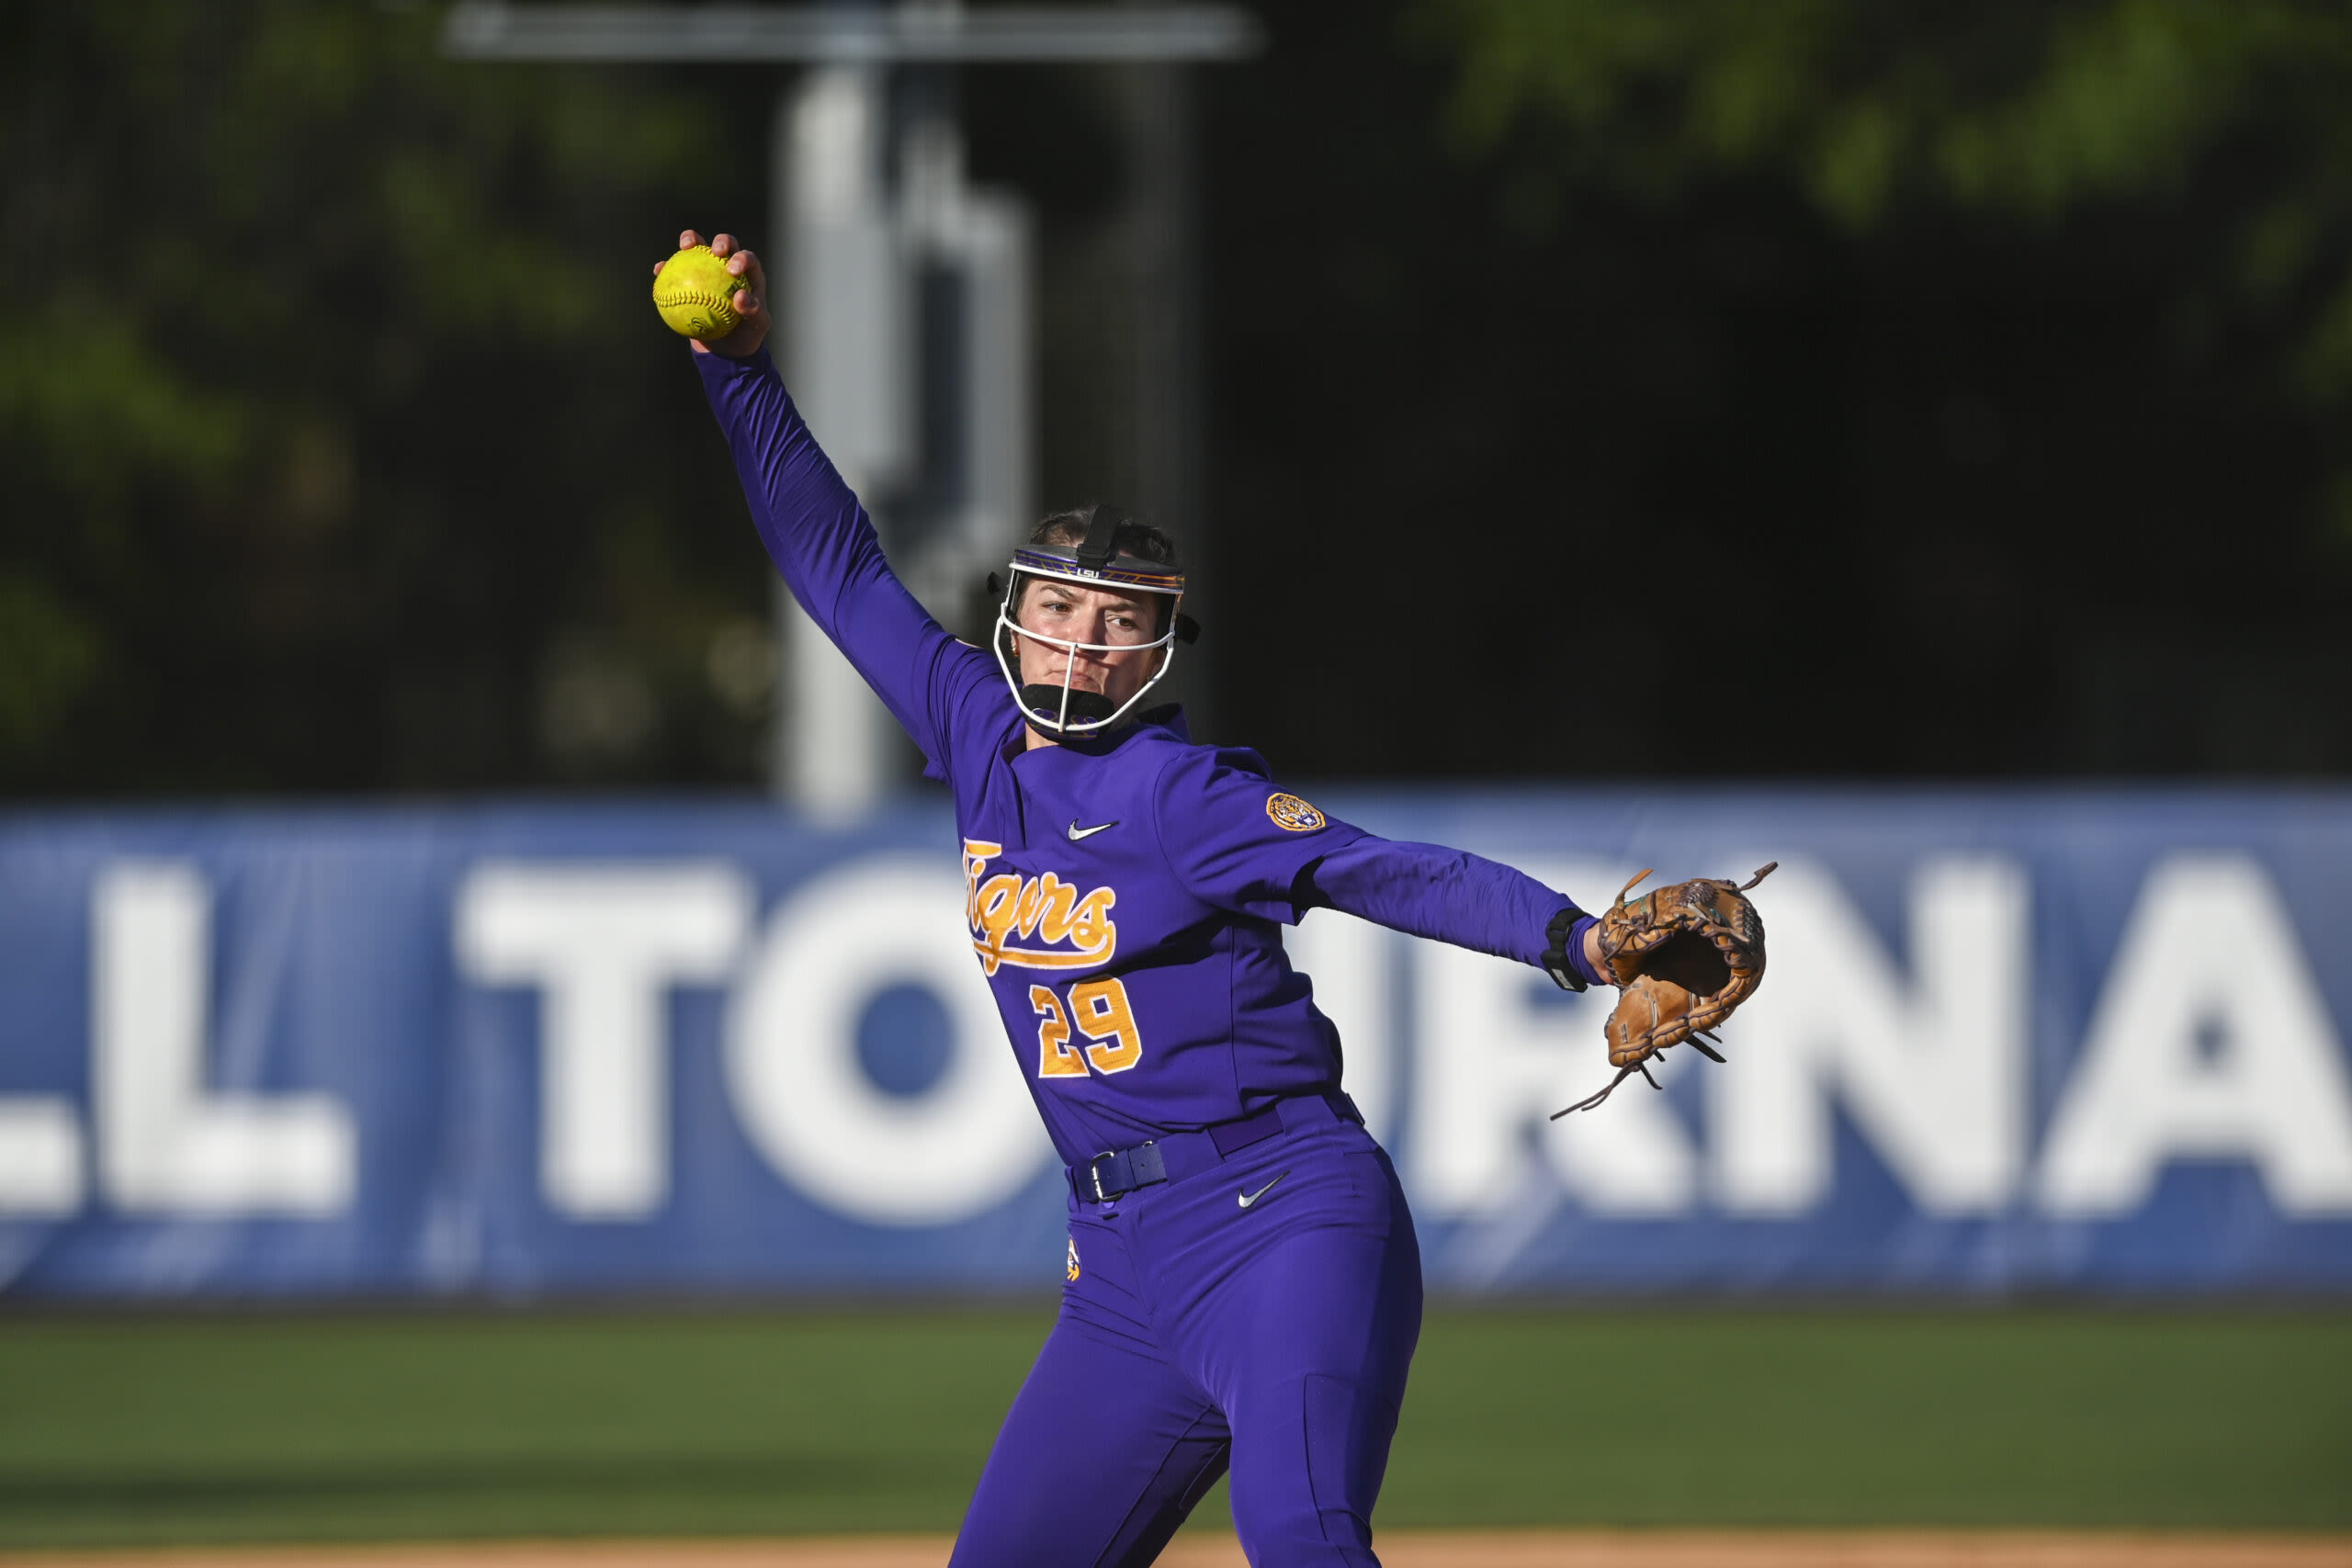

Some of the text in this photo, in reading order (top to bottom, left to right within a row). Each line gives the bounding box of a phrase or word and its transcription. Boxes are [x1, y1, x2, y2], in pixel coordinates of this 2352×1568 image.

[1076, 568, 1100, 579] LSU
[456, 858, 2352, 1222] TORNA
[1028, 974, 1143, 1078] 29
